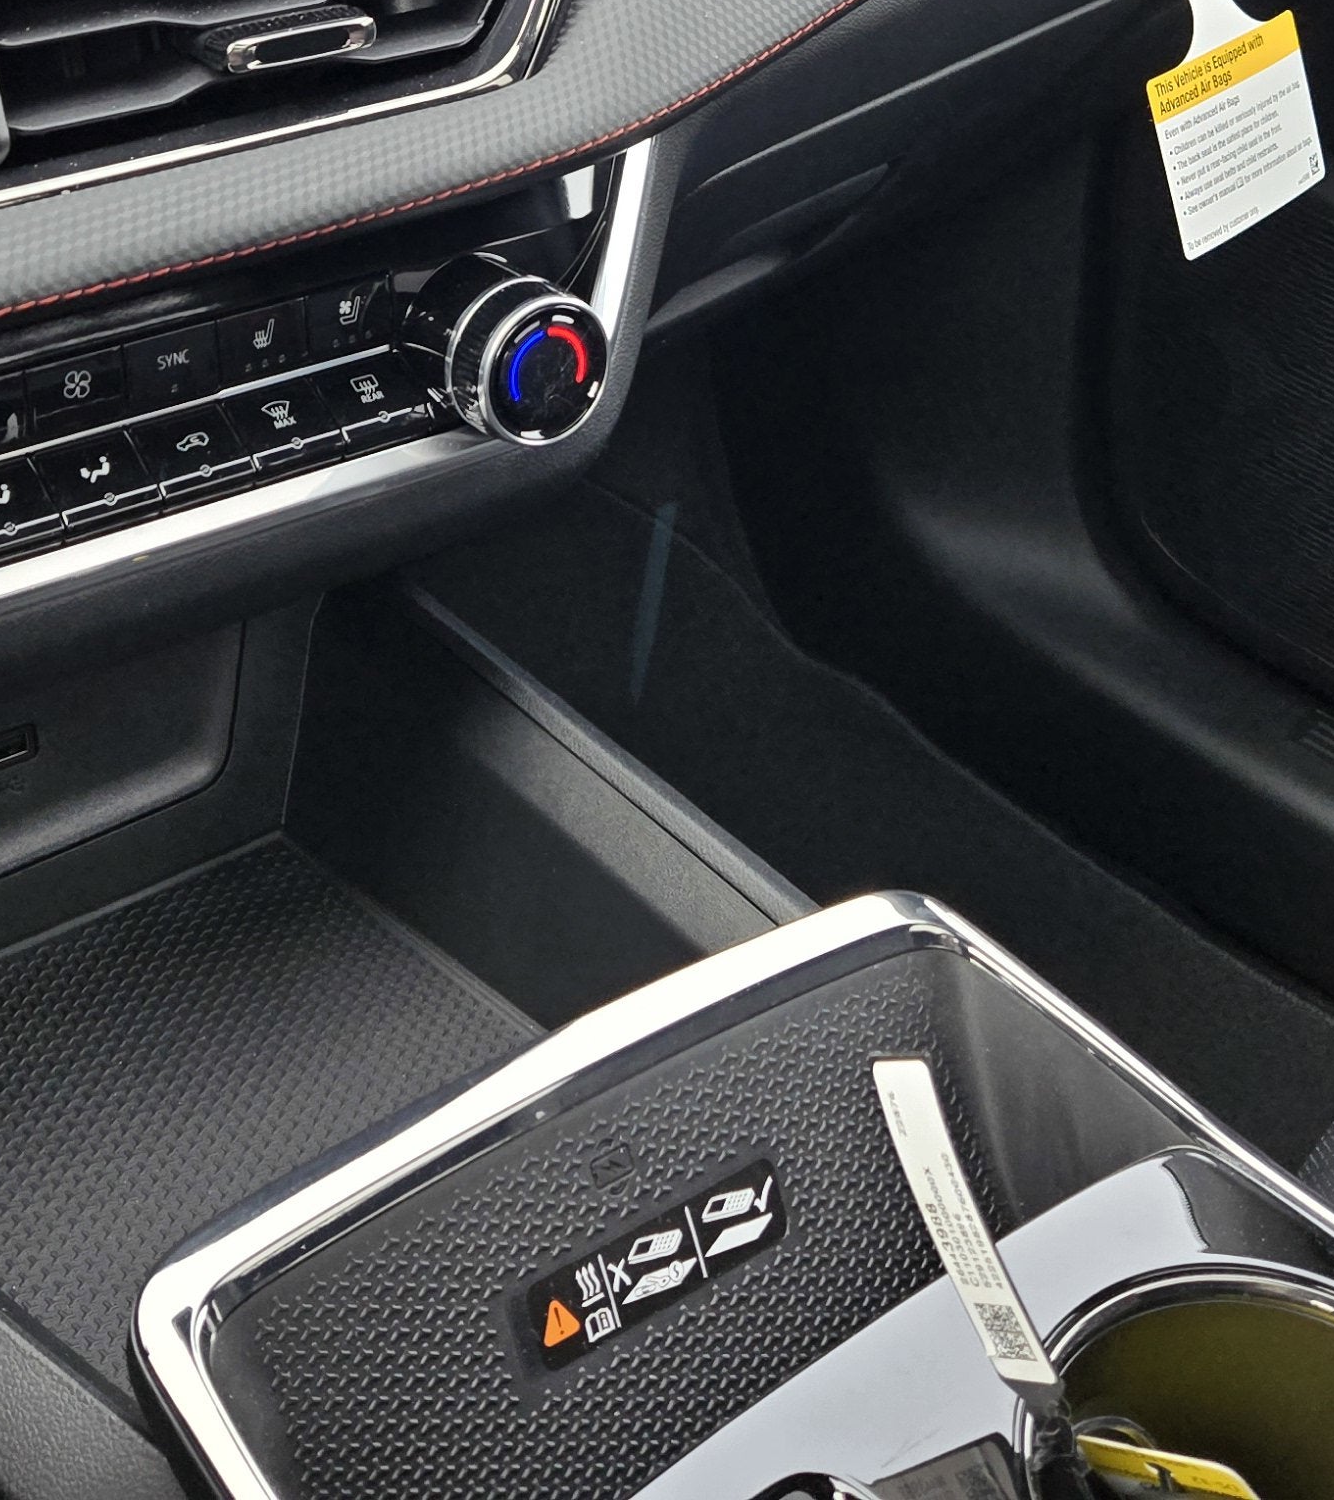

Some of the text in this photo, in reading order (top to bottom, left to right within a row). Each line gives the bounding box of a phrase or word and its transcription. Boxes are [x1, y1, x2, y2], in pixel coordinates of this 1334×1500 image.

[1154, 34, 1263, 97] This Vehicle is Equipped with
[1160, 70, 1232, 116] Advanced Air Bags
[1165, 127, 1179, 140] Even
[1180, 120, 1192, 132] with
[1193, 104, 1218, 126] Advanced
[157, 349, 190, 371] SYNC
[361, 391, 385, 403] REAR
[273, 416, 297, 430] MAX
